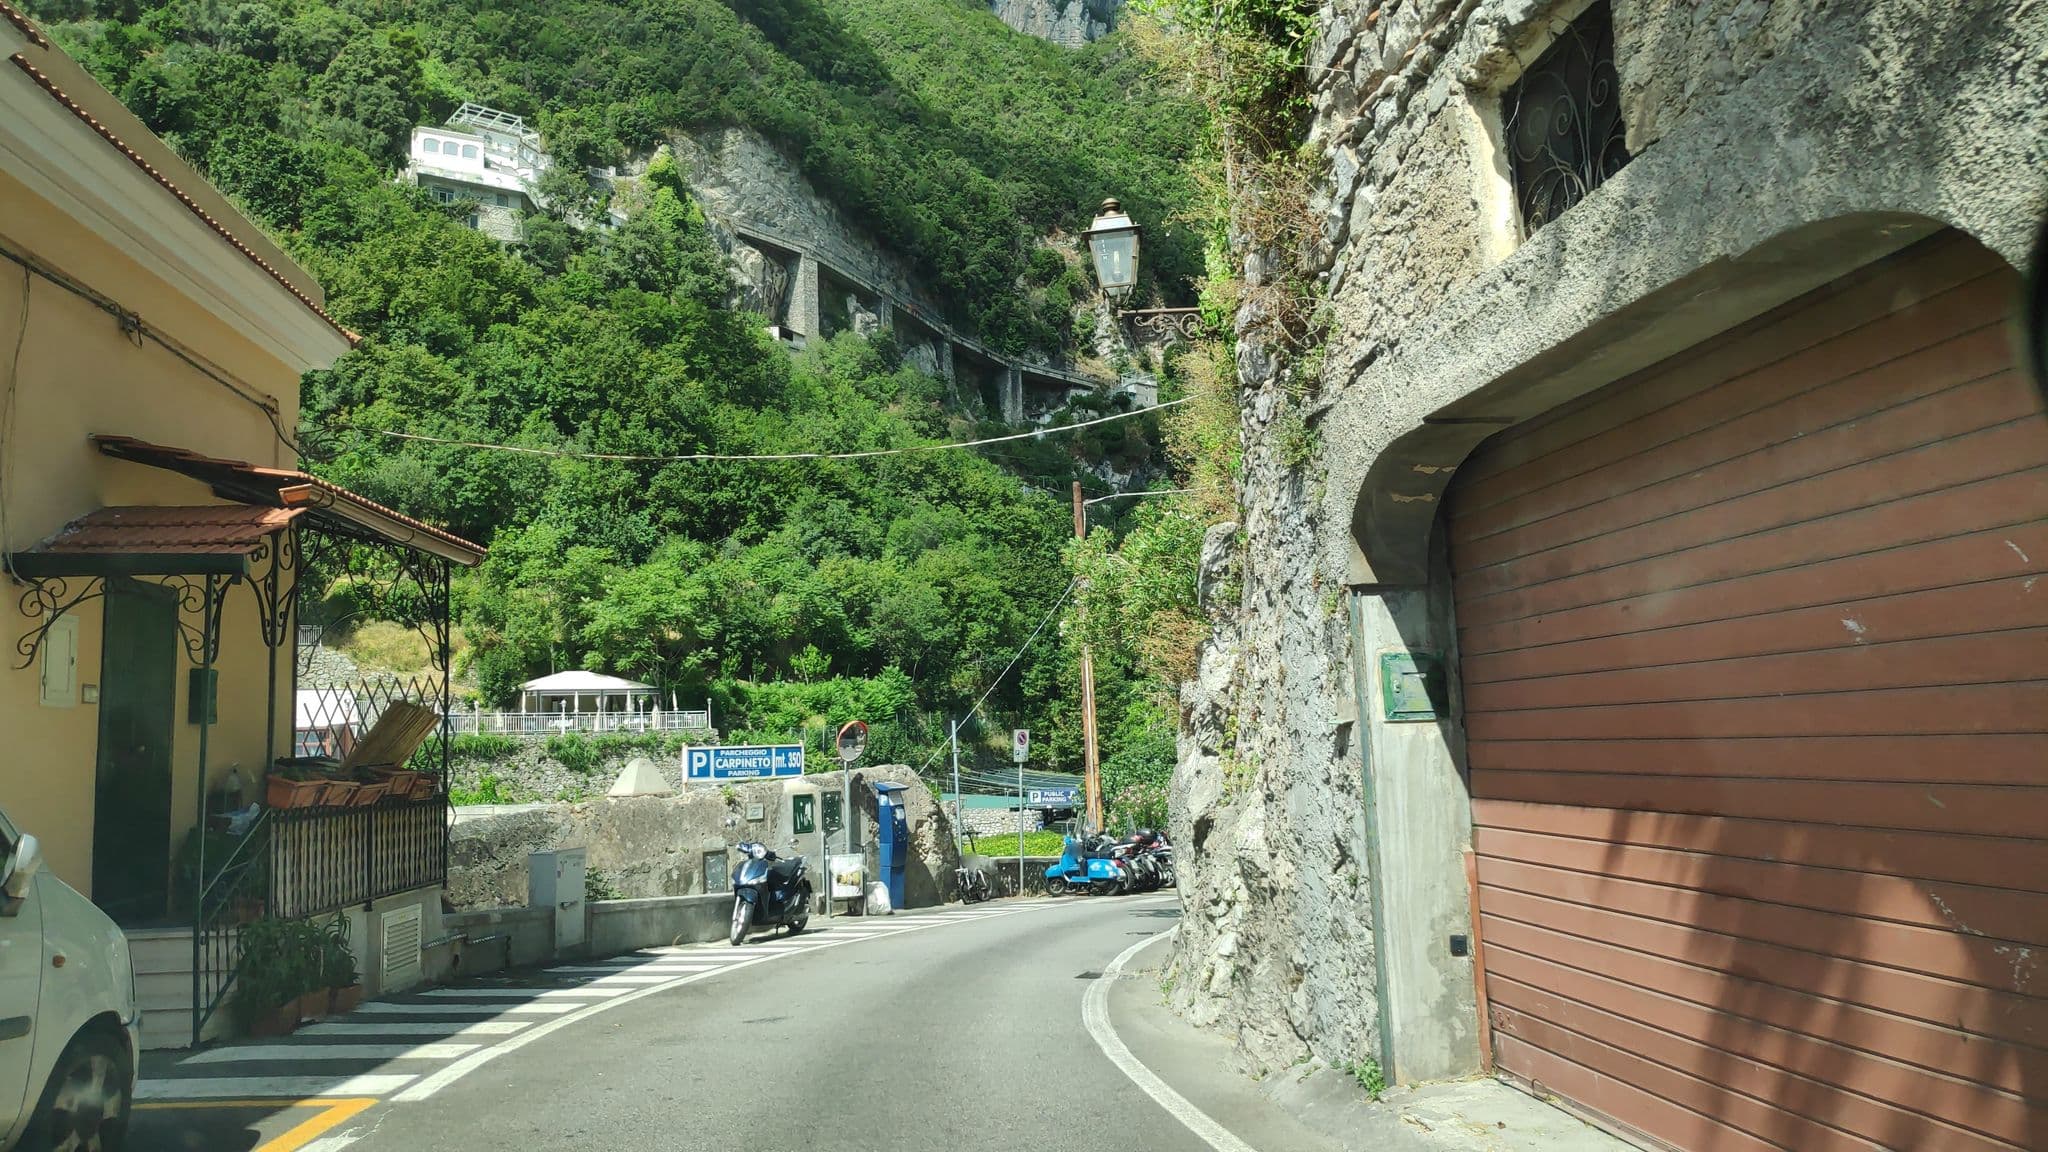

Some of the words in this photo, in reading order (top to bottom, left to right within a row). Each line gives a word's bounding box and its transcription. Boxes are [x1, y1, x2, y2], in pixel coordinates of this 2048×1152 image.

[693, 752, 707, 776] P
[715, 757, 771, 768] CARPINETO
[775, 753, 787, 768] mt.
[788, 752, 801, 768] 350
[1033, 792, 1039, 802] P
